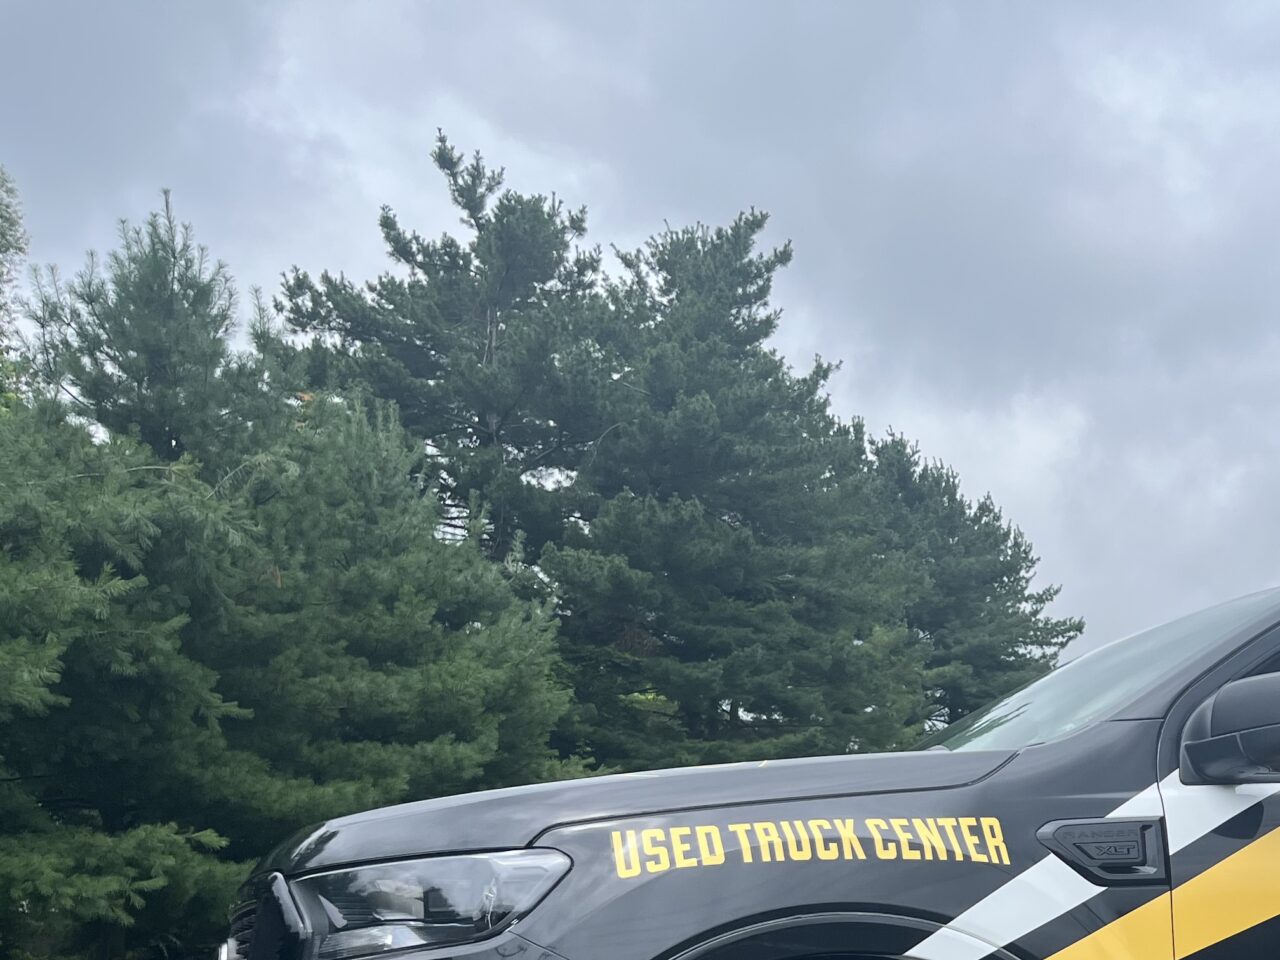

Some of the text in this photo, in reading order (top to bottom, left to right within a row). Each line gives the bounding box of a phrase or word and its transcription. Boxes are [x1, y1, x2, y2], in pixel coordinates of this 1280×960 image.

[610, 816, 1011, 879] USED TRUCK CENTER
[1094, 844, 1137, 857] XLT
